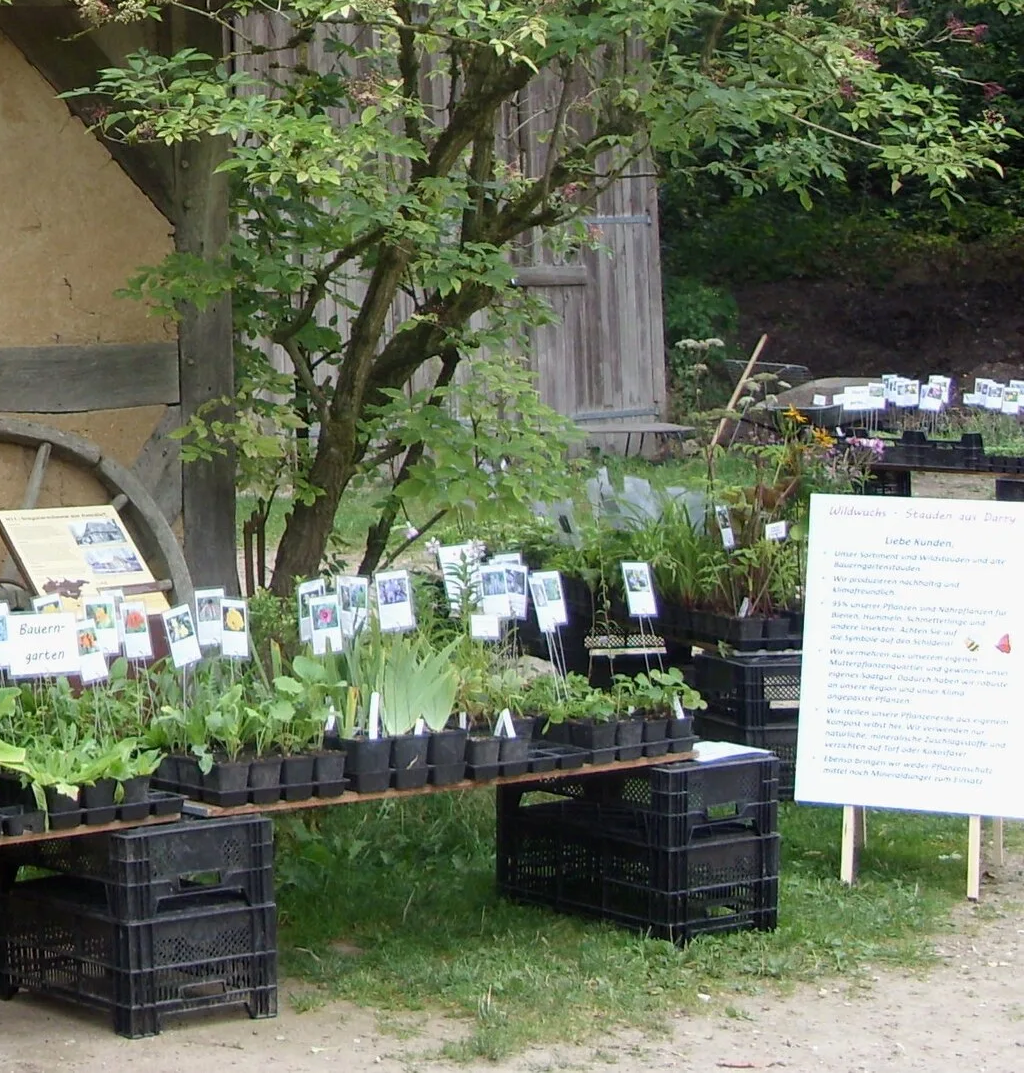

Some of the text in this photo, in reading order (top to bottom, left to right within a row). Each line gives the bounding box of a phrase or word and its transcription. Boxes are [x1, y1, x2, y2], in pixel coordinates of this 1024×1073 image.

[906, 508, 952, 519] Stauden
[960, 513, 976, 521] aus
[885, 536, 911, 546] Liebe
[20, 623, 65, 636] Bauern-
[26, 650, 65, 664] garten
